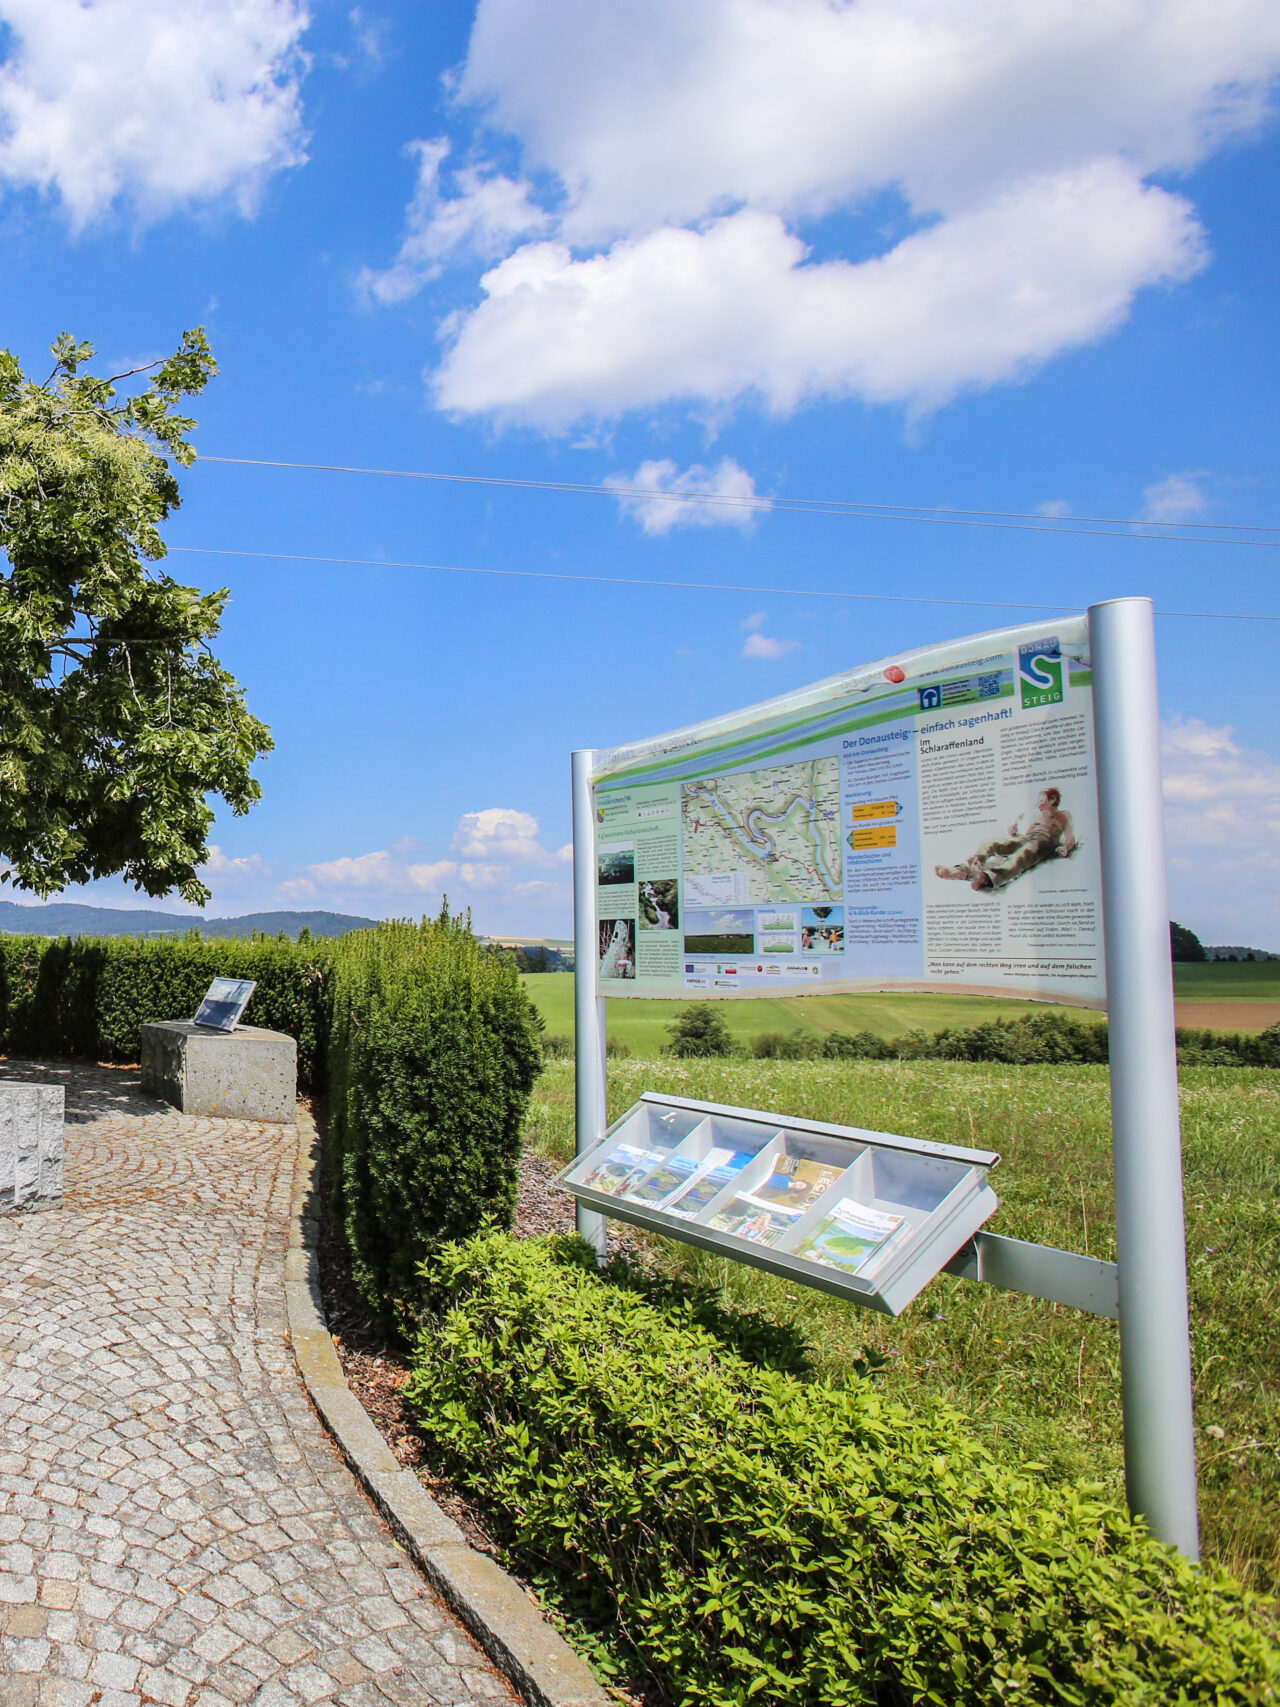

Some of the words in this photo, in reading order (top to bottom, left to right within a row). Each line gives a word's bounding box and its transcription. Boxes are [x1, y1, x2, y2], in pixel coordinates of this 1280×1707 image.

[1020, 639, 1058, 654] DONAU
[1024, 693, 1061, 706] STEIG
[842, 740, 858, 749] Der
[920, 719, 955, 734] einfach
[958, 708, 1013, 732] sagenhaft!
[920, 736, 984, 754] Schlaraffenland
[798, 1170, 833, 1210] LEGION
